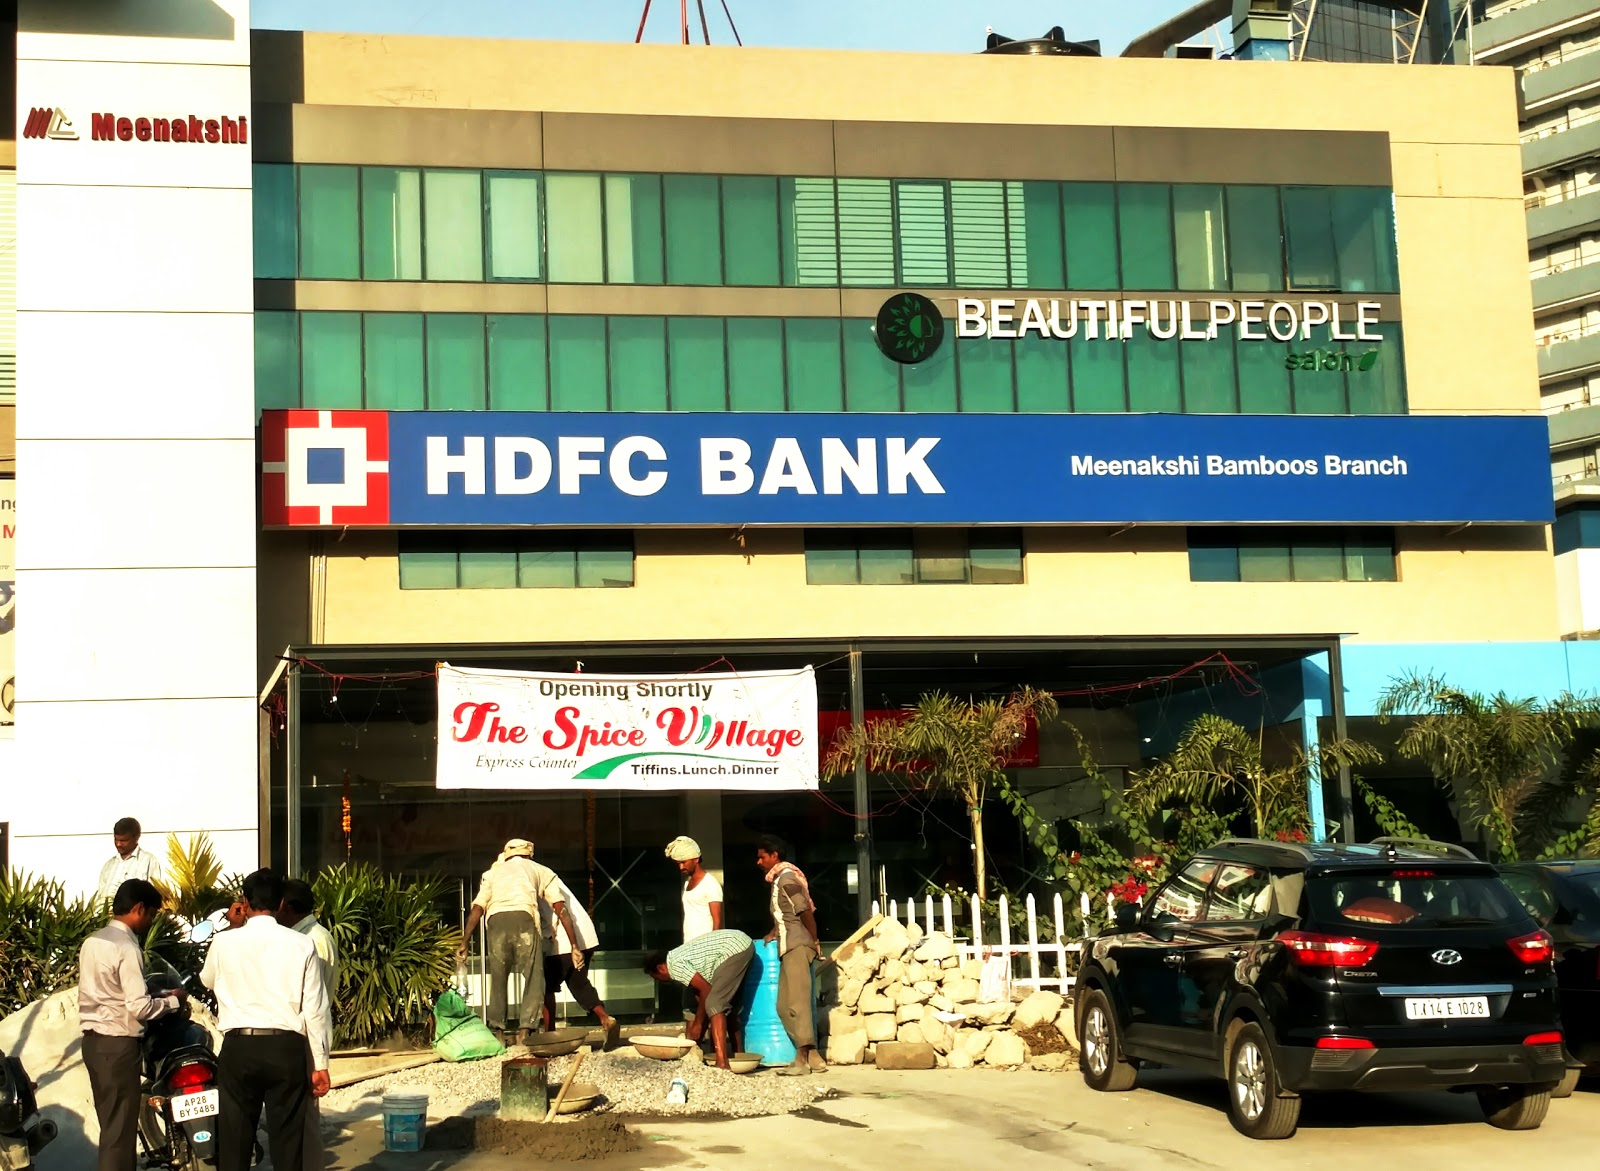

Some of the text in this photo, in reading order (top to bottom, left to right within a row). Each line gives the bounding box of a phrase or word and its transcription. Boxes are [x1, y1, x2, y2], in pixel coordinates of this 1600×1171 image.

[91, 113, 248, 145] Meenakshi
[1285, 349, 1352, 371] salon
[425, 435, 947, 497] HDFC BANK
[1070, 455, 1408, 476] Meenakshi Bamboos Branch
[539, 680, 713, 702] Opening Shortly
[453, 701, 804, 757] The Spice Village
[476, 754, 580, 773] Express Counter
[179, 1103, 216, 1119] BY 5489
[184, 1095, 207, 1108] AP28
